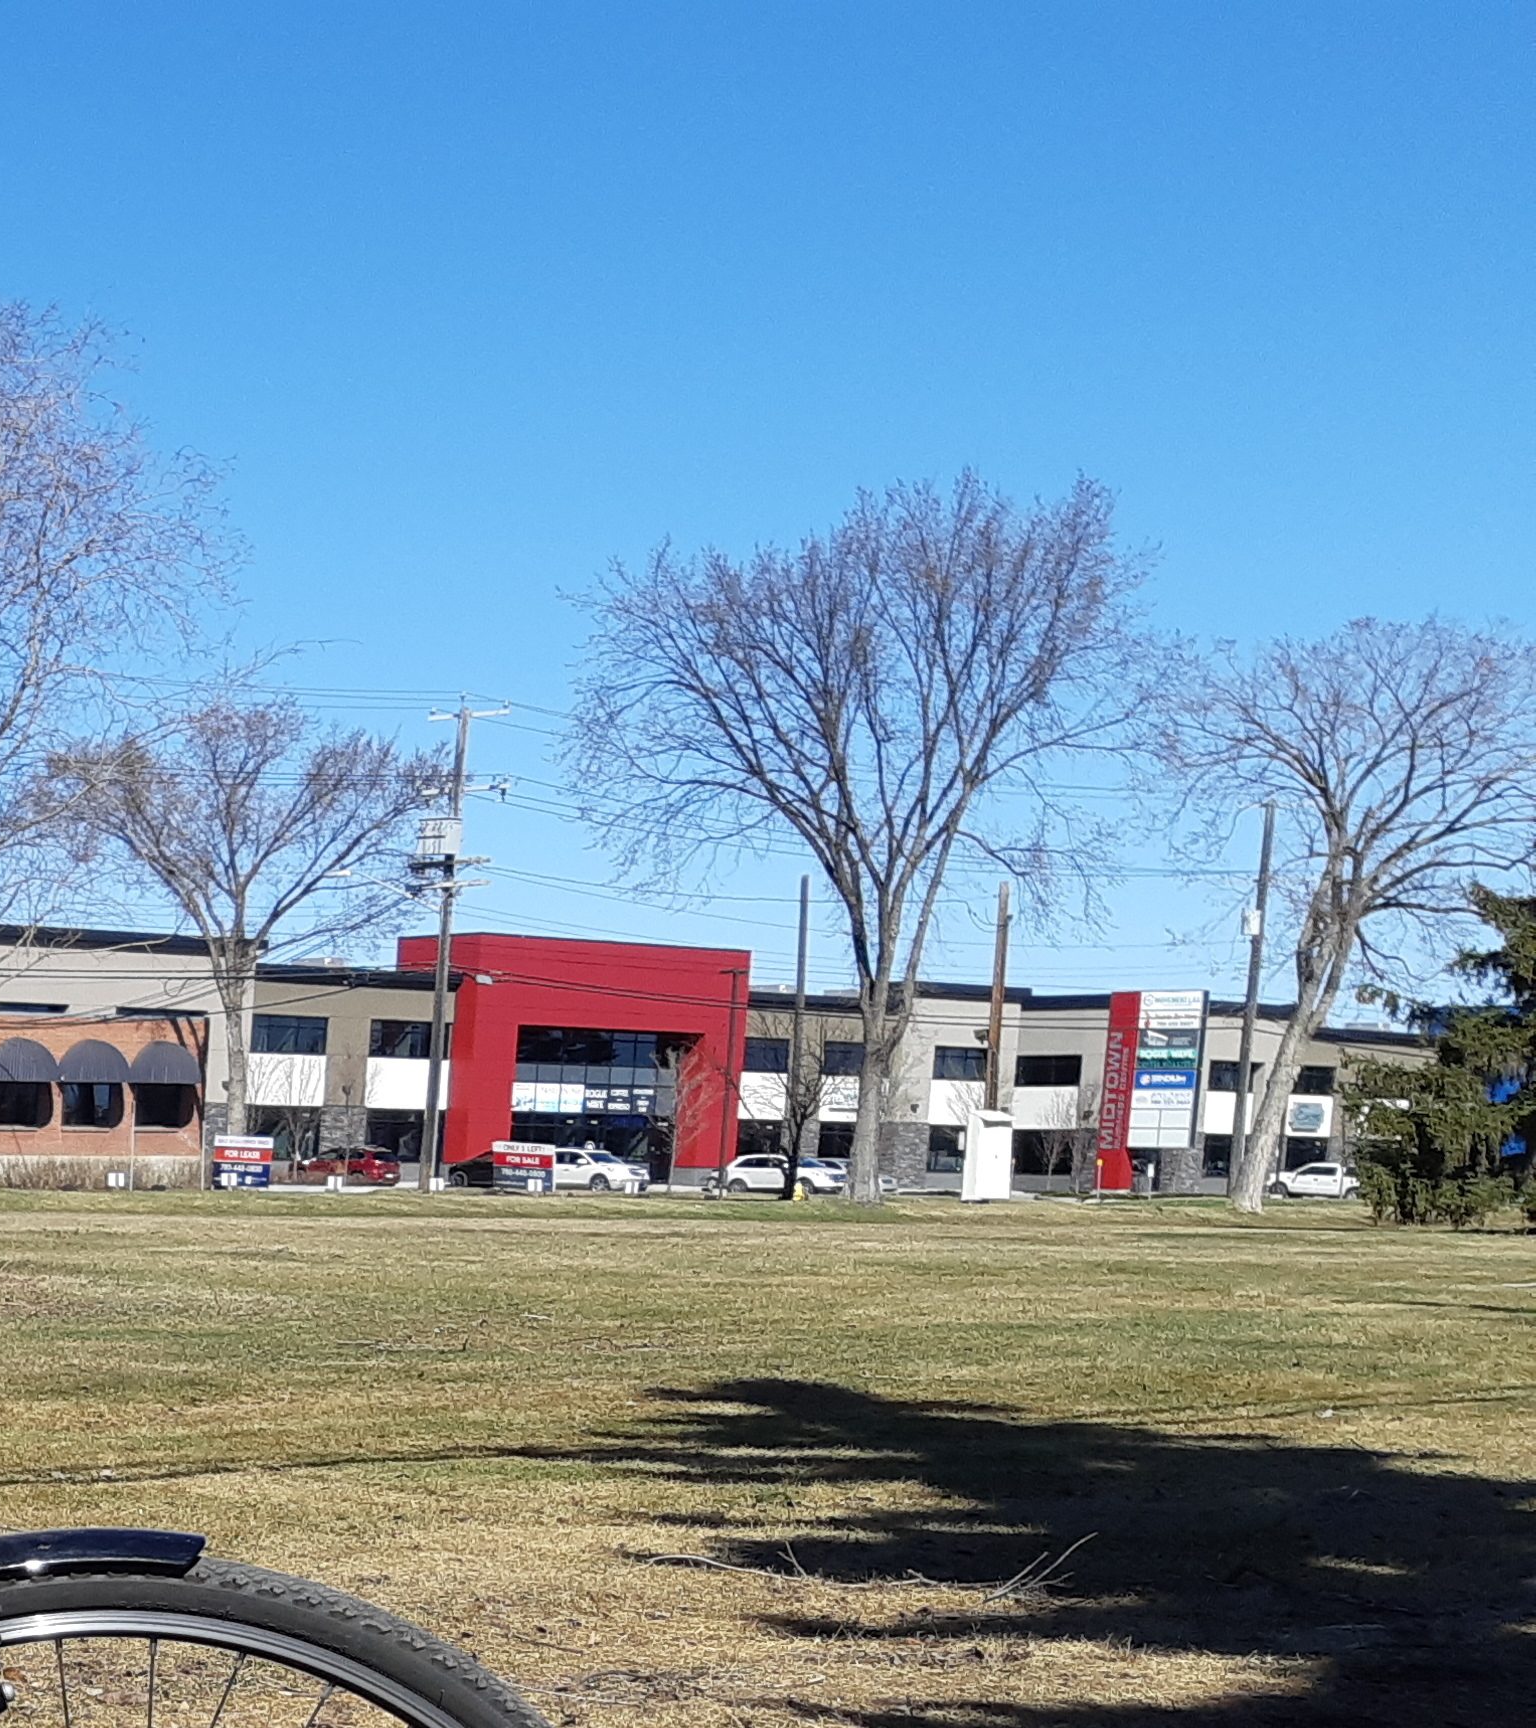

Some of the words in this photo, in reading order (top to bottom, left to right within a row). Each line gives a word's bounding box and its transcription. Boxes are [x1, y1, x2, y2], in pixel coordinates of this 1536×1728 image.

[1099, 1031, 1124, 1150] MIDTOWN
[224, 1149, 239, 1158] FOR
[239, 1150, 261, 1160] LEASE
[505, 1155, 521, 1164] FOR
[521, 1156, 541, 1165] SALE
